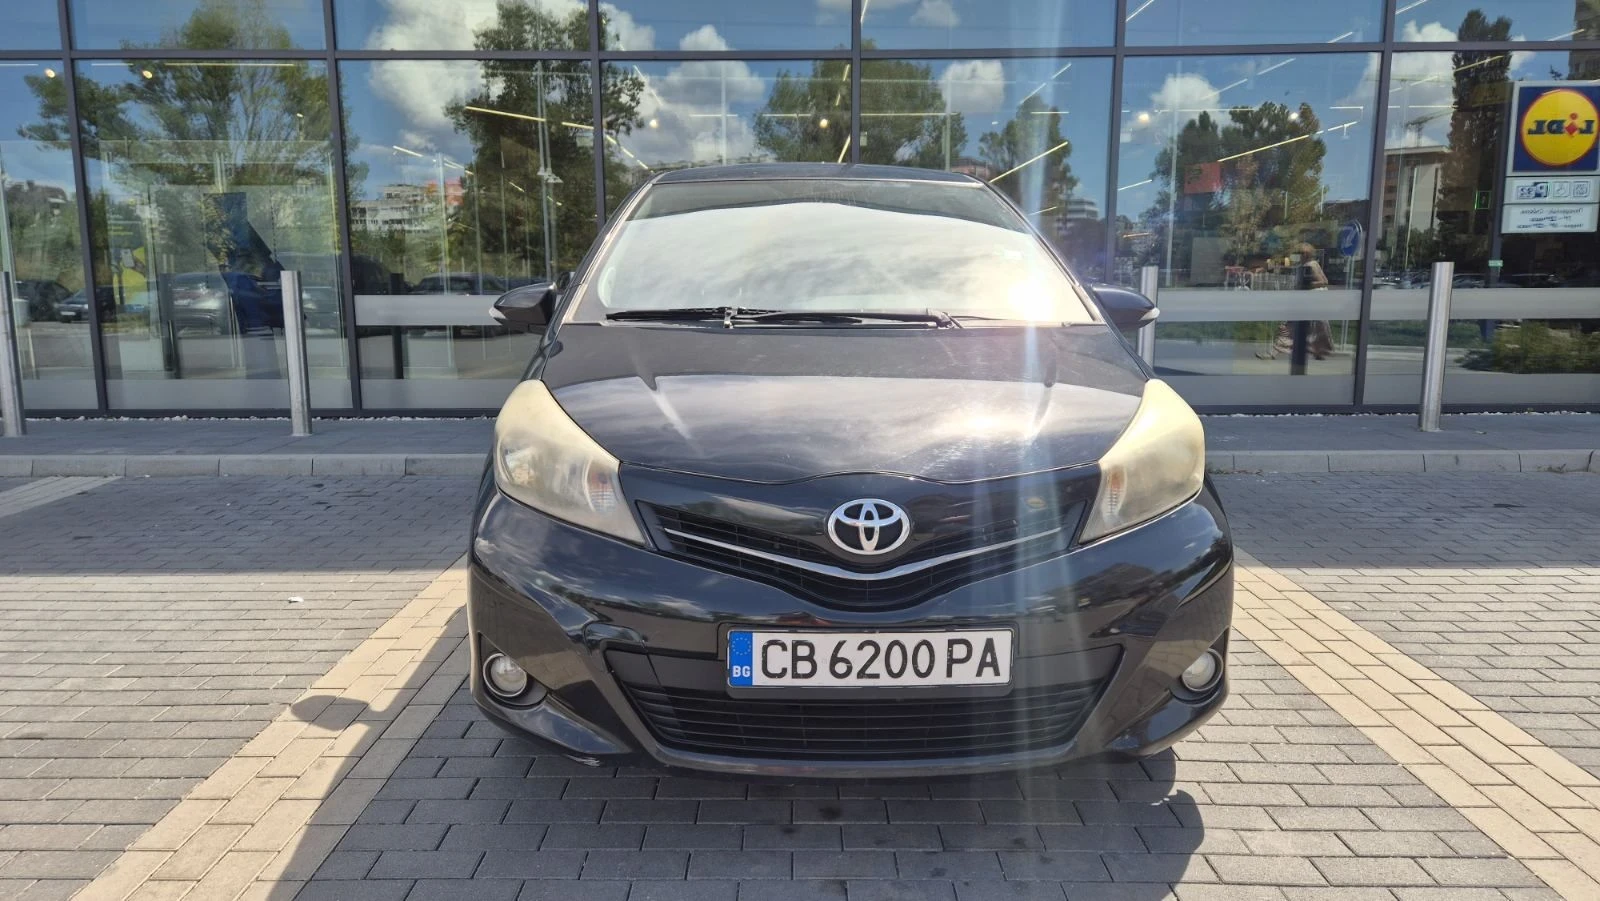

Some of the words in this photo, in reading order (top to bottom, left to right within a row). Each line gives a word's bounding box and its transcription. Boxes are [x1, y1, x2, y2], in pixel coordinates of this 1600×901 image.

[733, 665, 750, 678] BG
[761, 639, 818, 680] CB
[829, 639, 936, 680] 6200
[946, 637, 1001, 678] PA
